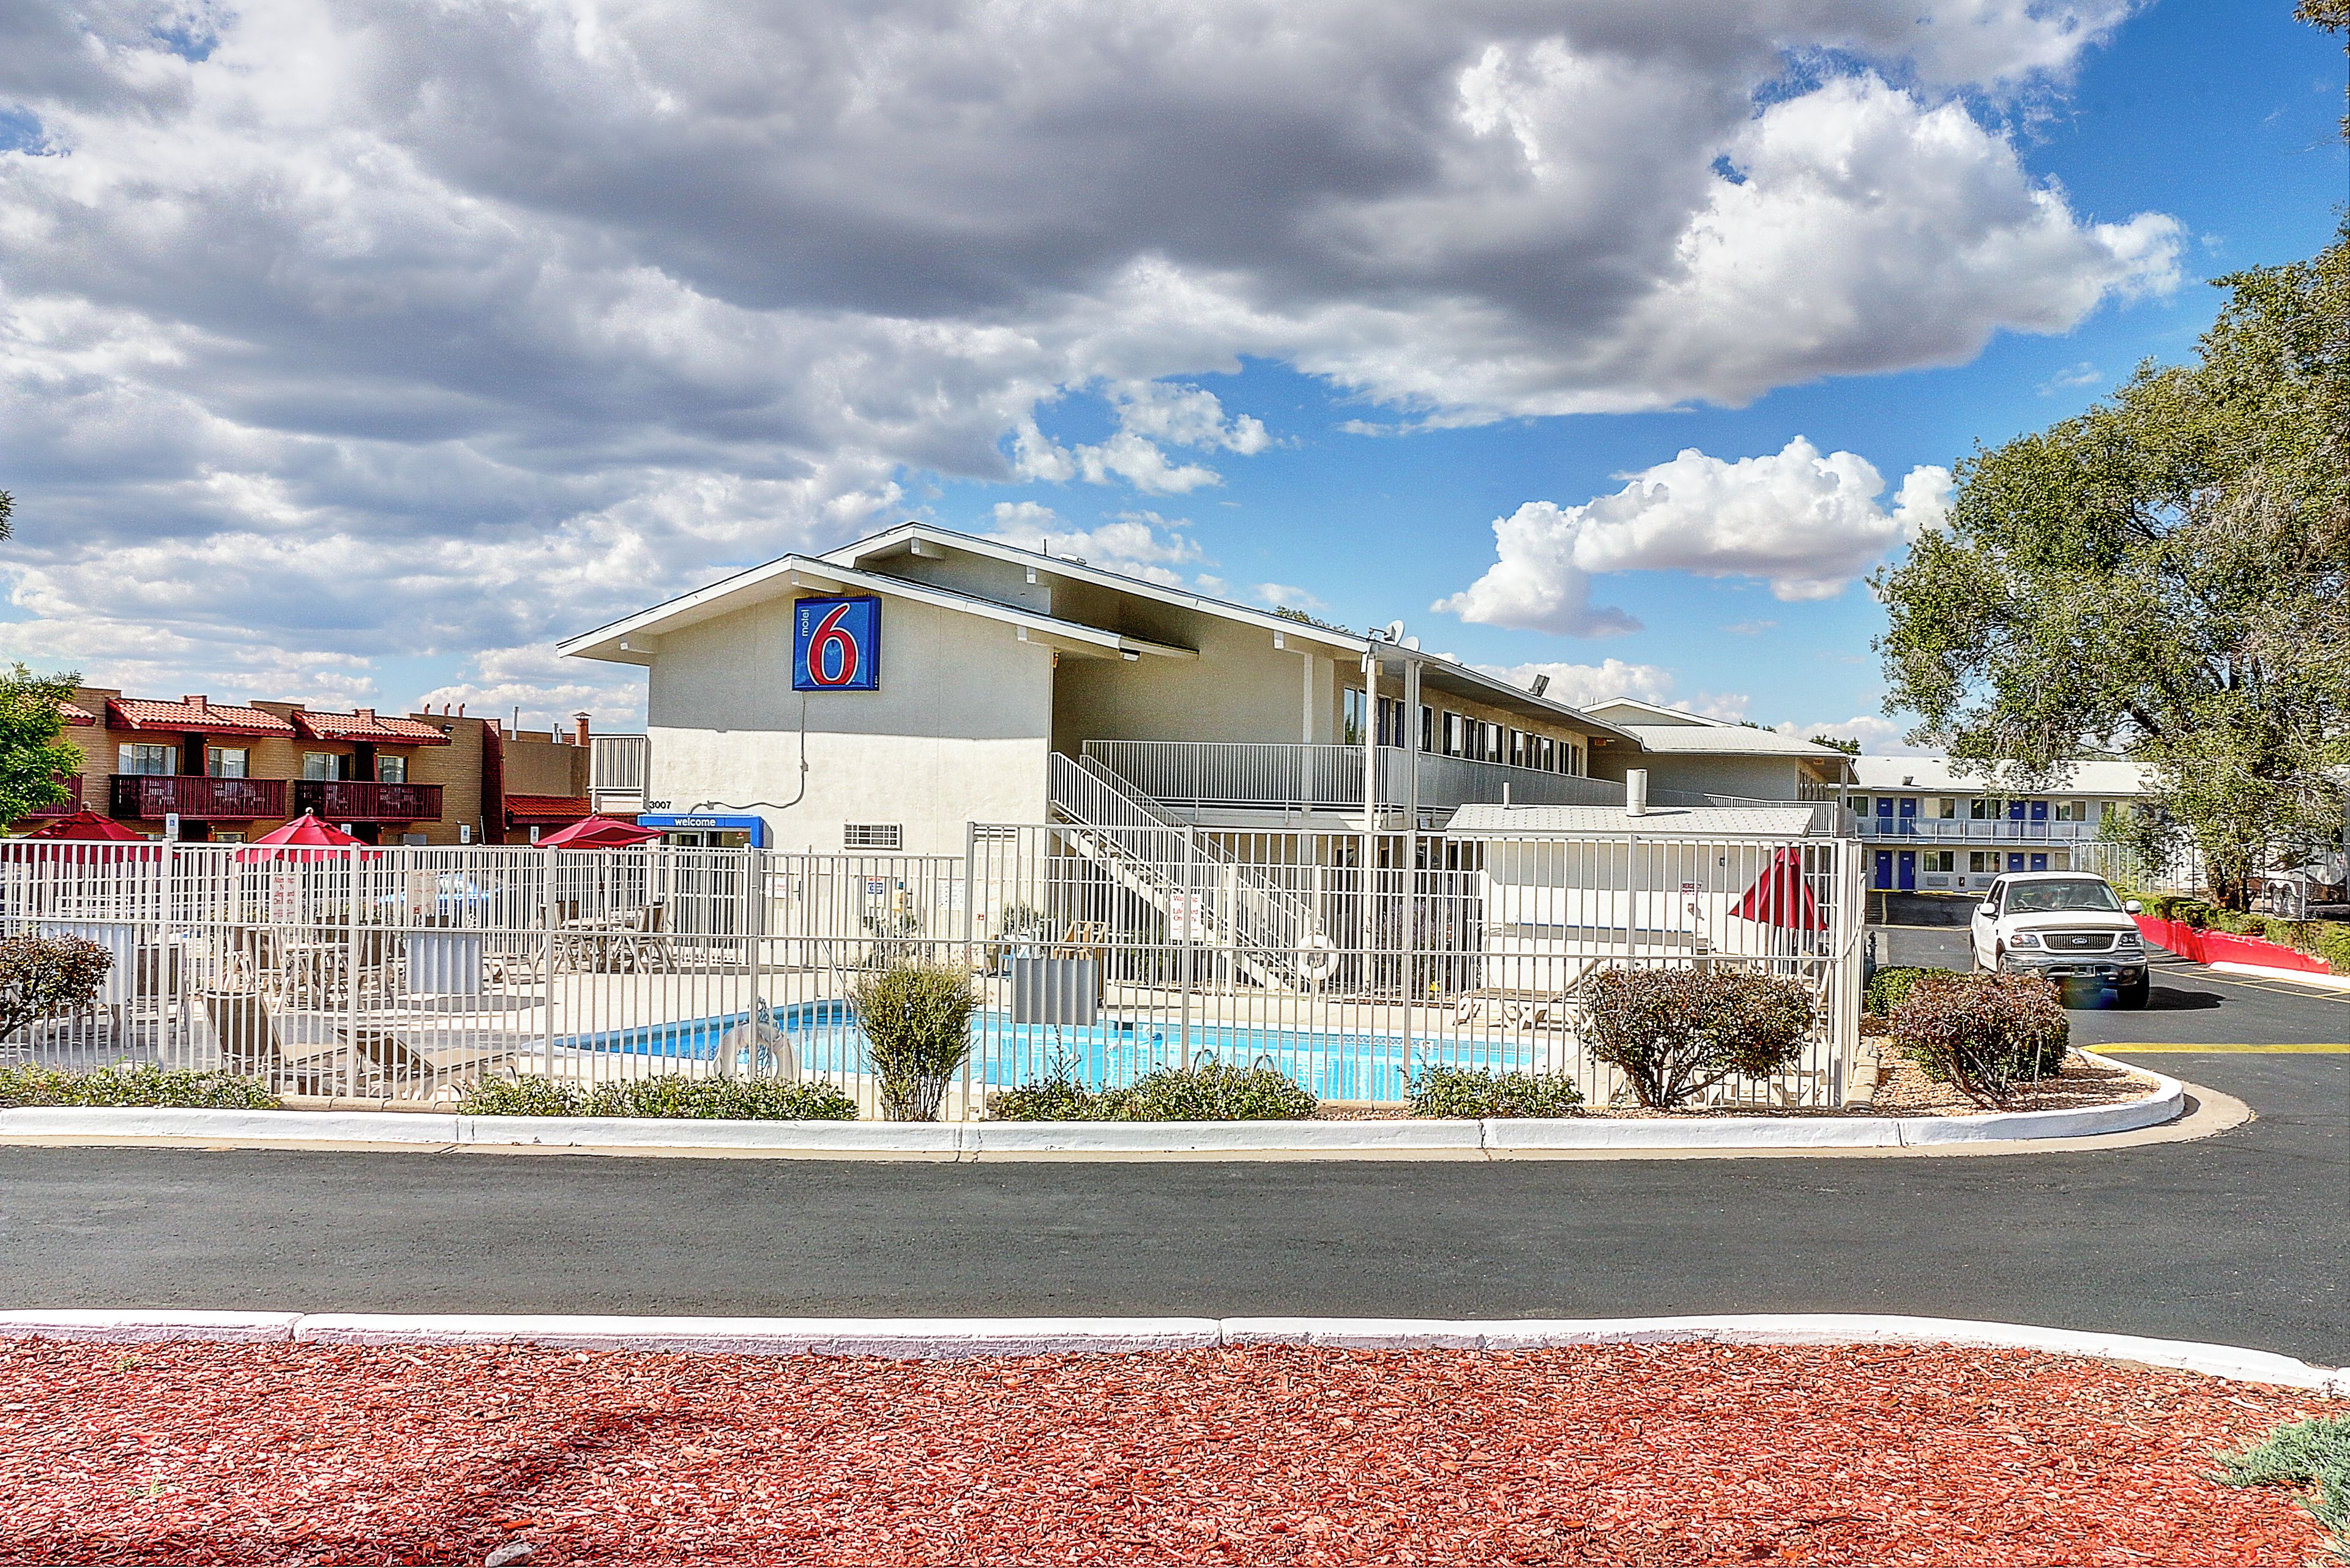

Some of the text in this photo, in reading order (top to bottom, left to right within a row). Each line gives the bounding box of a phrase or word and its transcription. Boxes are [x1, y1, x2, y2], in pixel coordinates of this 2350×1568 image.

[800, 609, 809, 637] motel
[807, 602, 859, 685] 6
[649, 801, 671, 809] 3007
[674, 817, 716, 827] welcome
